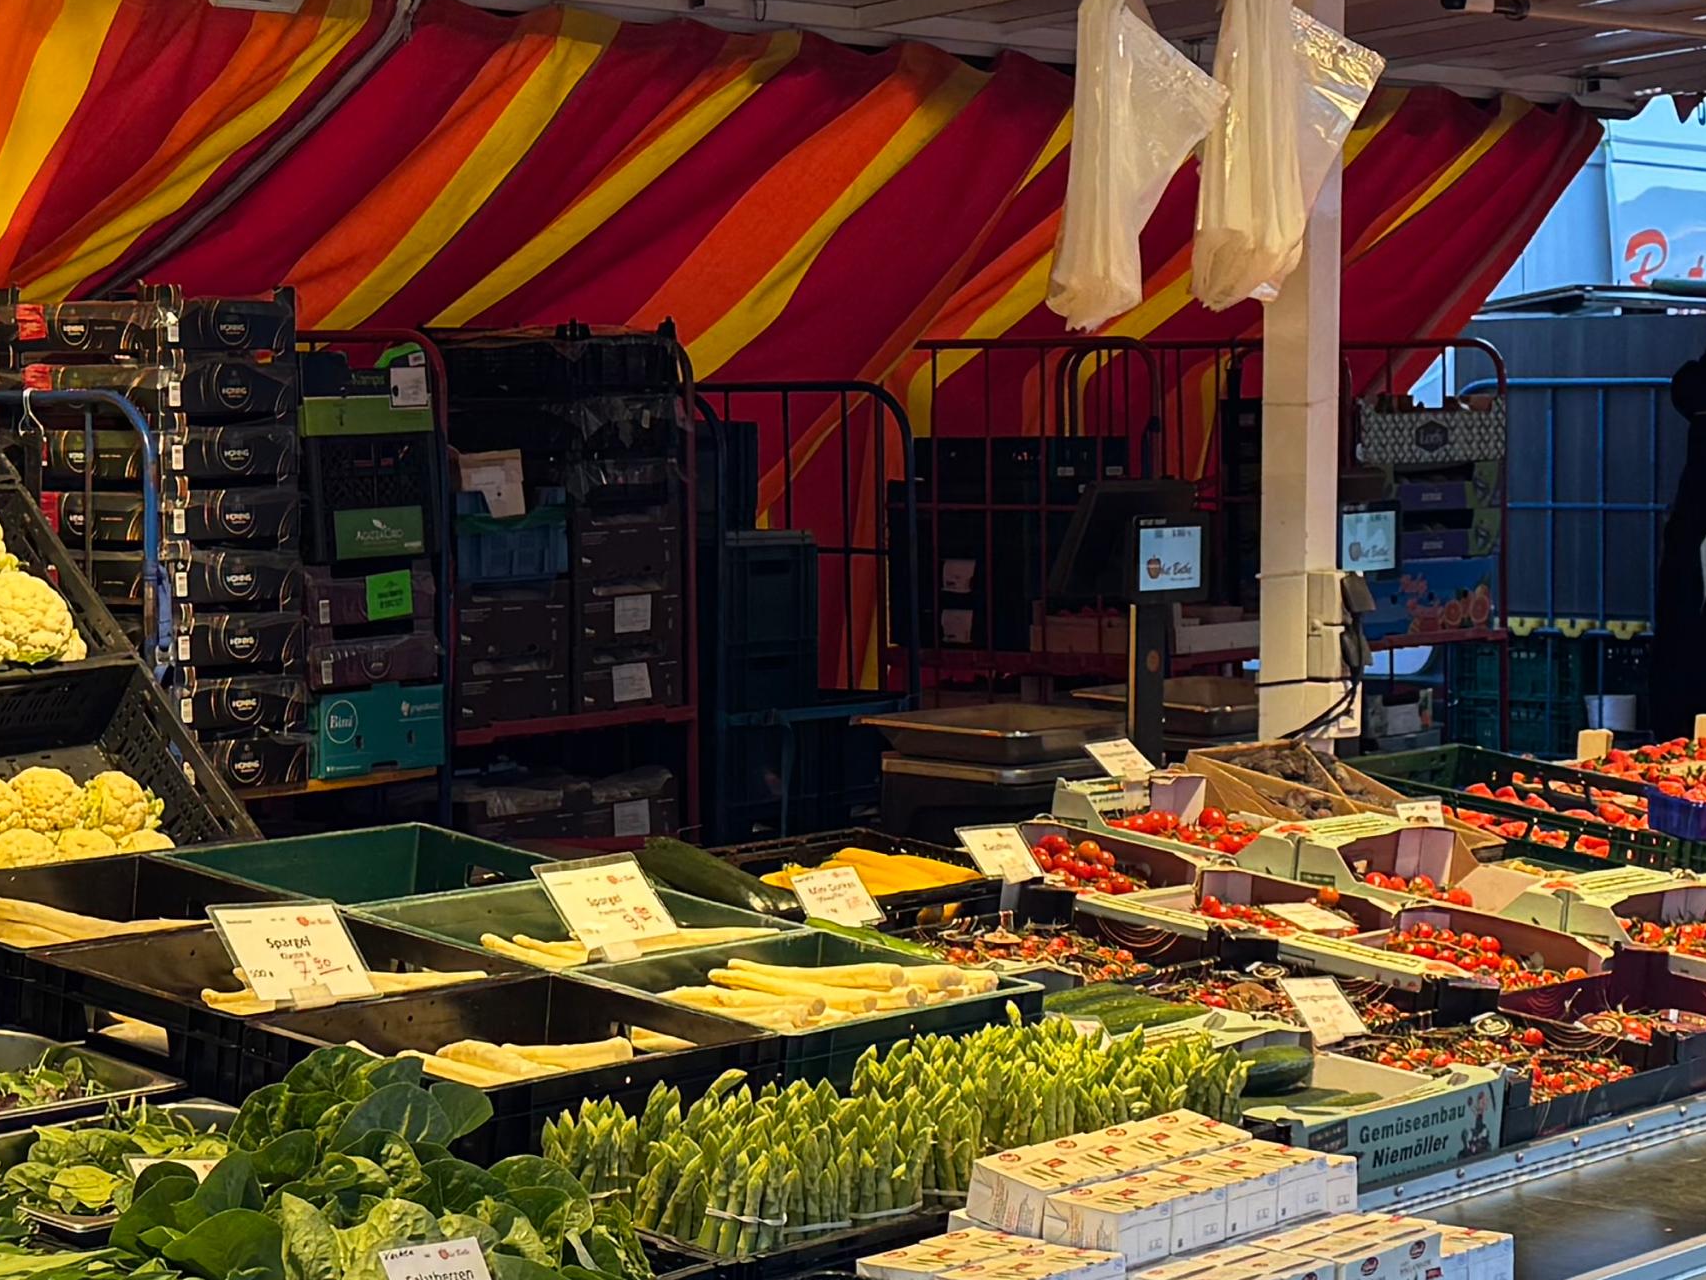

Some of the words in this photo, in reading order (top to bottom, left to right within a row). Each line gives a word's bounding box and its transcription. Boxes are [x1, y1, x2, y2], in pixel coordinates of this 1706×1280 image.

[266, 935, 311, 950] Spargel
[1359, 1103, 1466, 1145] Gemüseanbau
[1372, 1134, 1449, 1169] Niemöller
